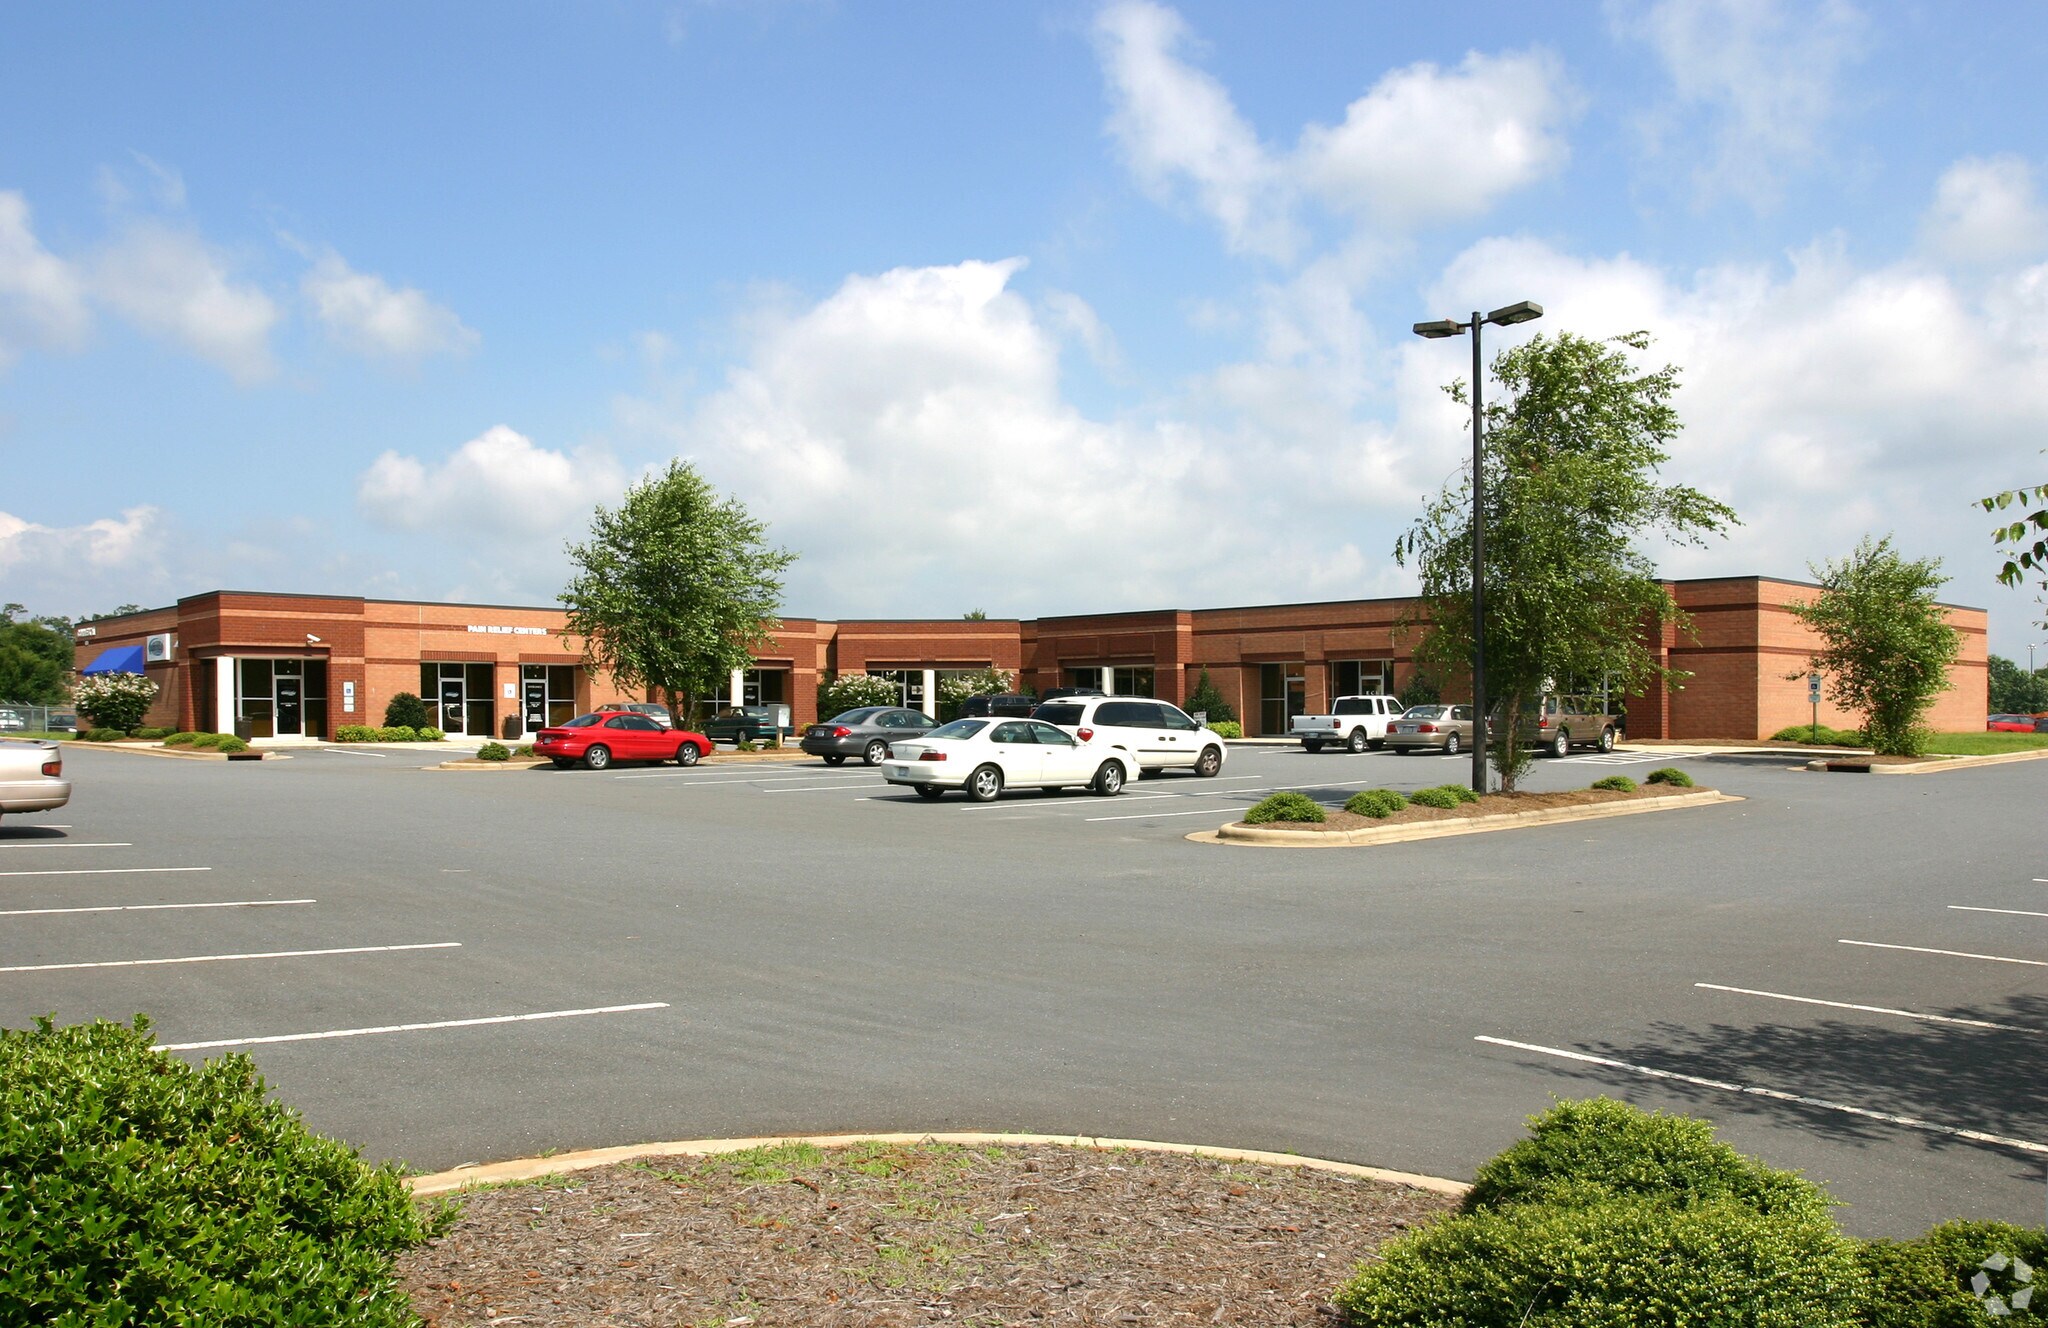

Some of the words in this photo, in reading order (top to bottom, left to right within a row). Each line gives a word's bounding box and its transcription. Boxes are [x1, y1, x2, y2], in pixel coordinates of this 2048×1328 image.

[467, 624, 487, 633] PAIN
[487, 625, 513, 634] RELIEF
[514, 626, 547, 636] CENTERS
